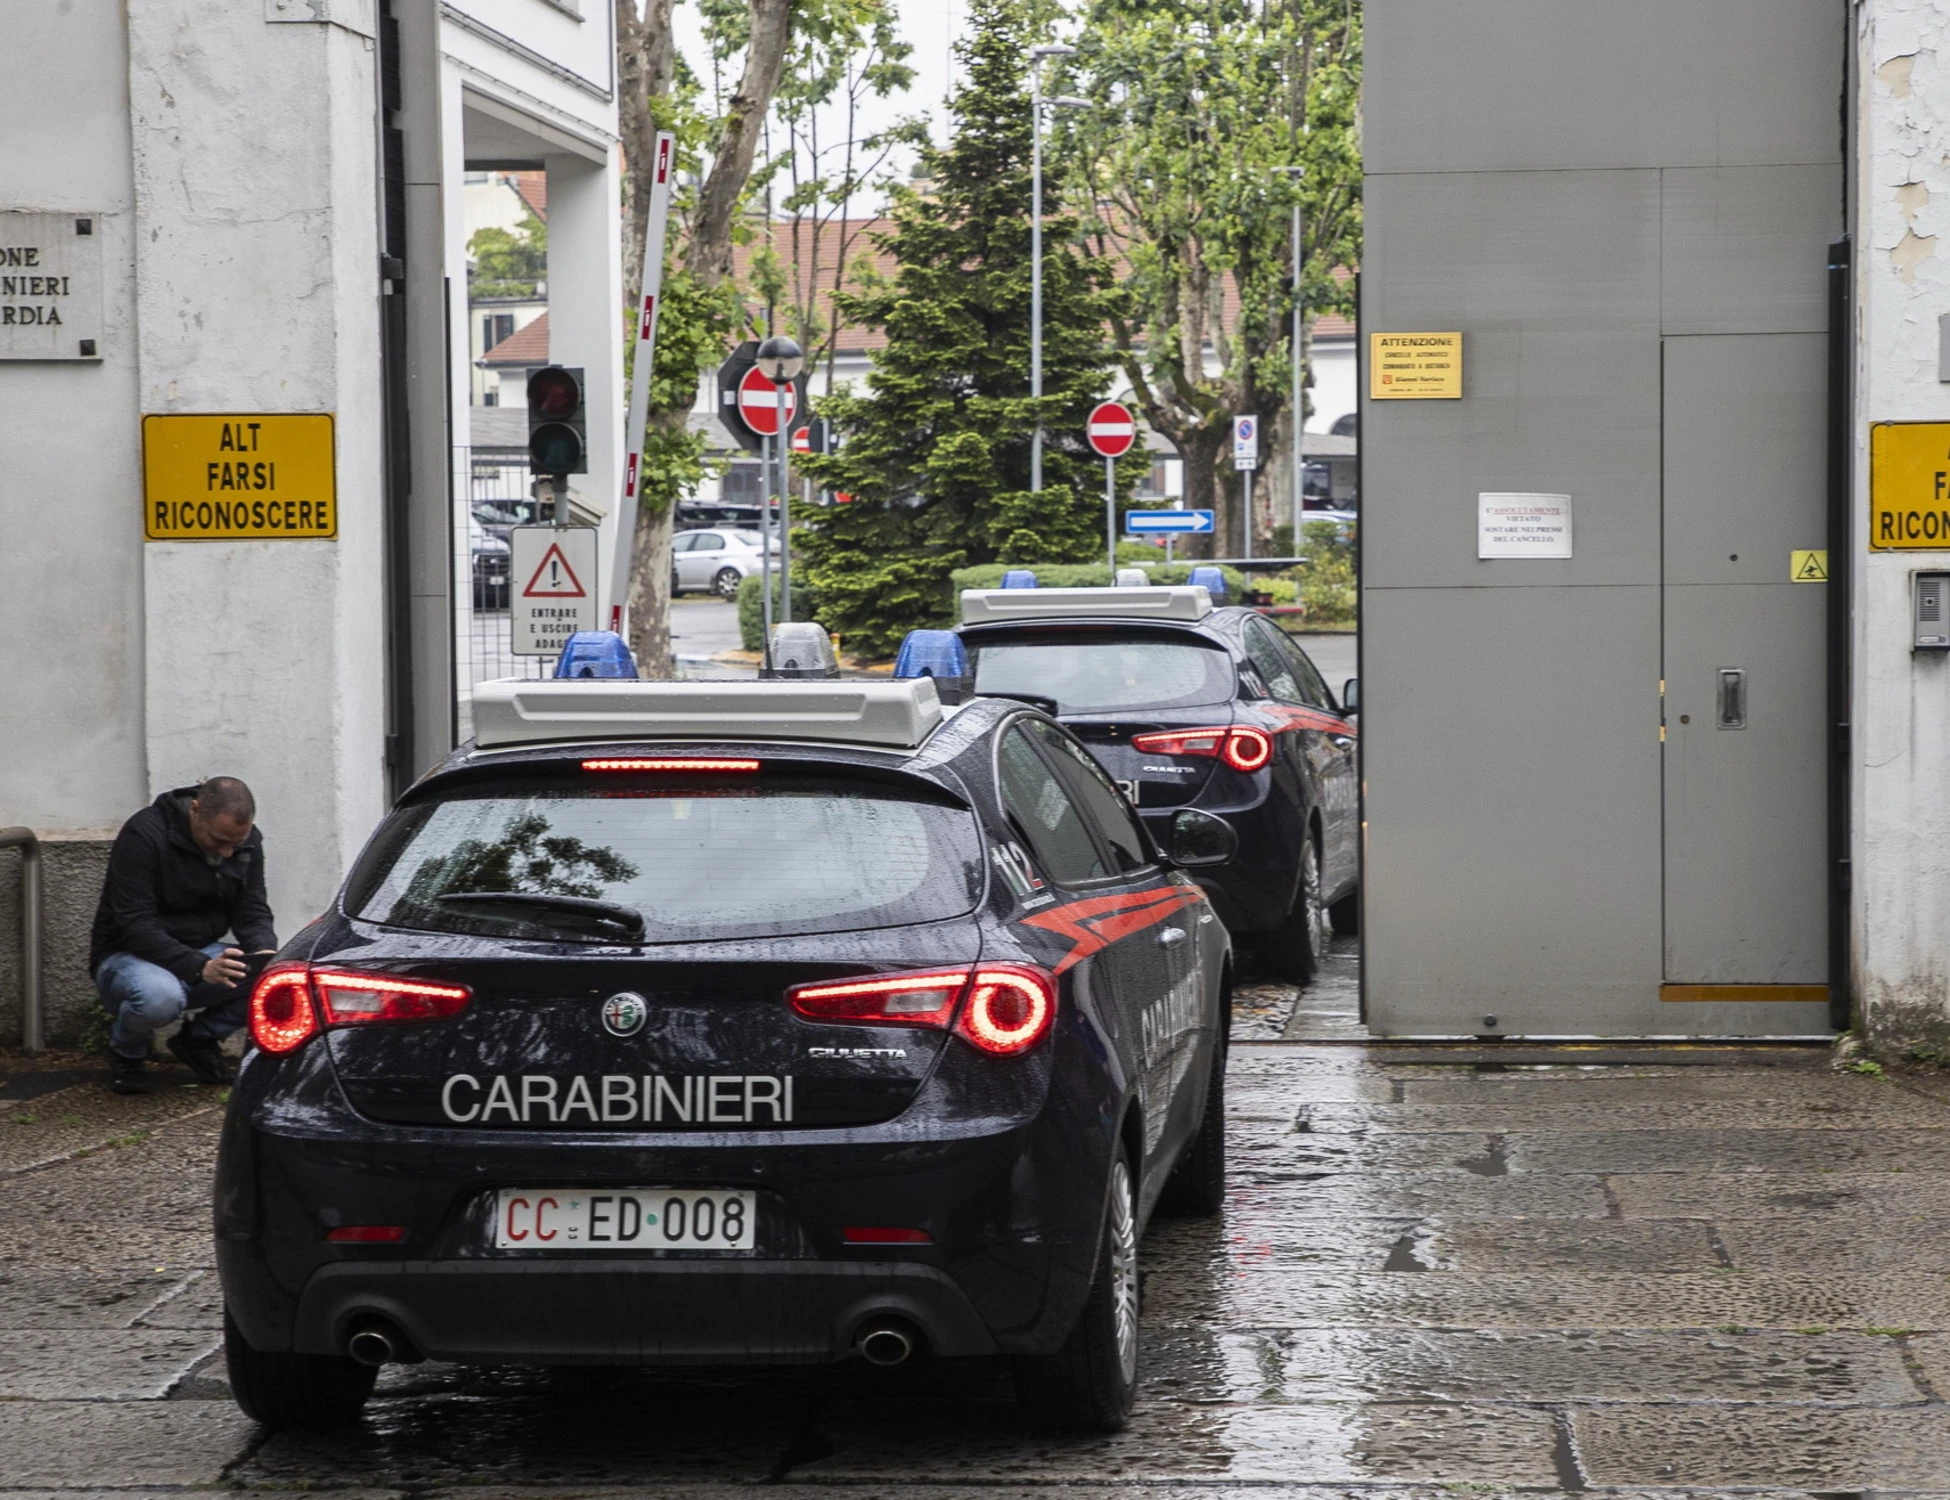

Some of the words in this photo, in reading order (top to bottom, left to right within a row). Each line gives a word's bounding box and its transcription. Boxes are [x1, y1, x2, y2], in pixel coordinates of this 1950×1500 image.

[2, 306, 63, 325] RDIA
[1381, 338, 1454, 346] ATTENZIONE
[219, 423, 261, 451] ALT
[207, 462, 275, 491] FARSI
[1934, 471, 1950, 500] F
[155, 501, 328, 530] RICONOSCERE
[531, 608, 577, 618] ENTRARE
[530, 624, 536, 633] E
[541, 624, 578, 633] USCIRE
[535, 639, 564, 648] ADAG
[808, 1047, 907, 1059] GIULIETTA
[442, 1074, 793, 1123] CARABINIERI
[506, 1197, 559, 1241] CC
[588, 1196, 642, 1241] ED
[662, 1197, 745, 1242] 008
